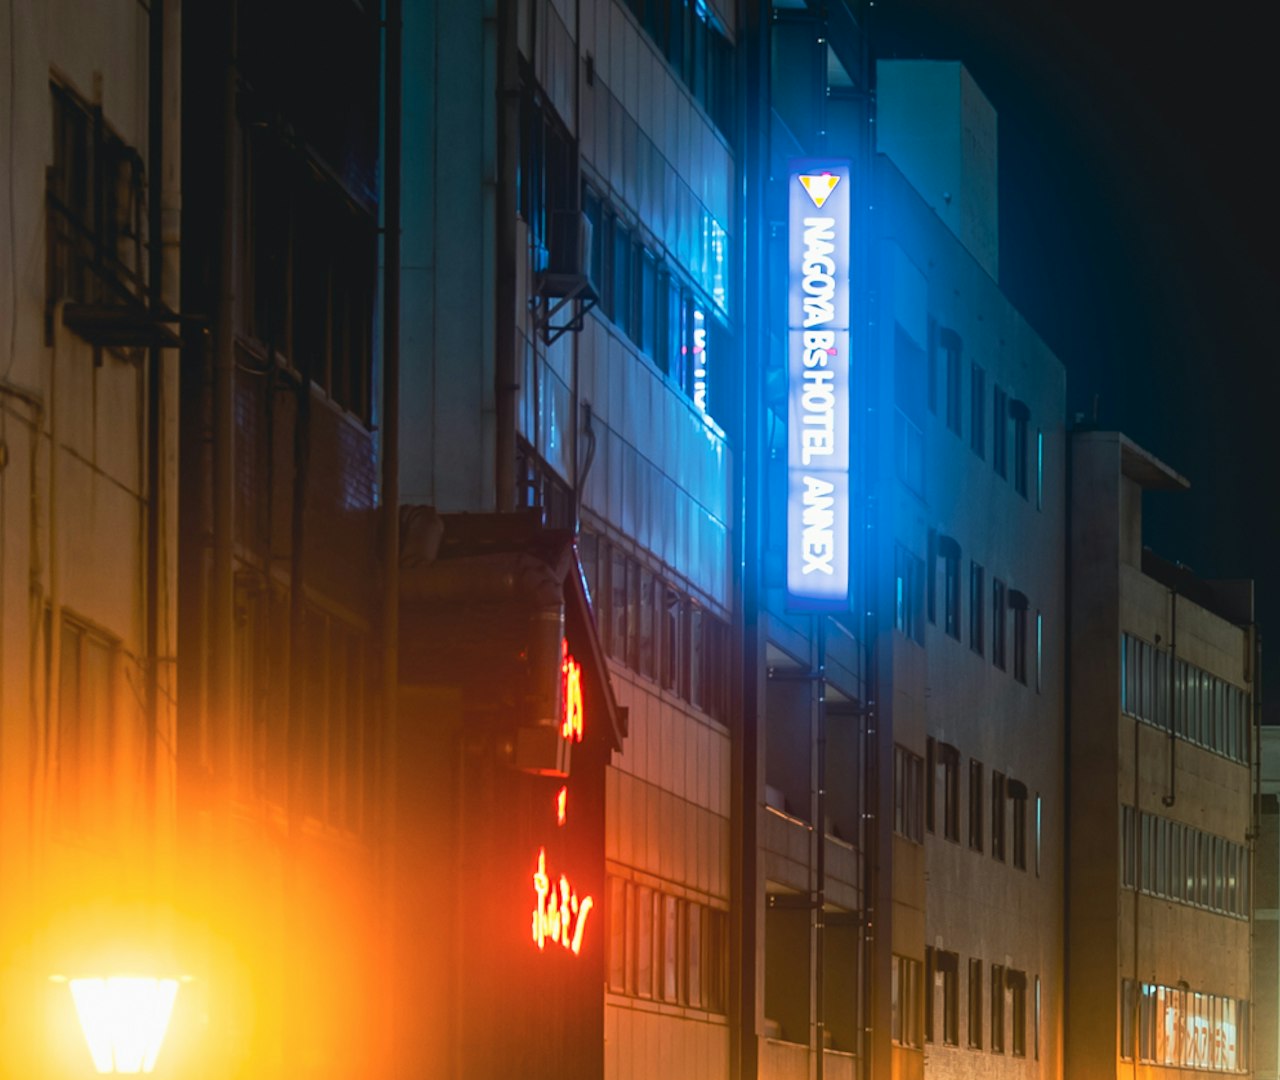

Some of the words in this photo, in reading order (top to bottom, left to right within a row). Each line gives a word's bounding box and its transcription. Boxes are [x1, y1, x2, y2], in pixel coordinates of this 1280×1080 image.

[802, 216, 836, 328] NAGOYA
[801, 370, 836, 467] HOTEL
[801, 475, 835, 576] ANNEX
